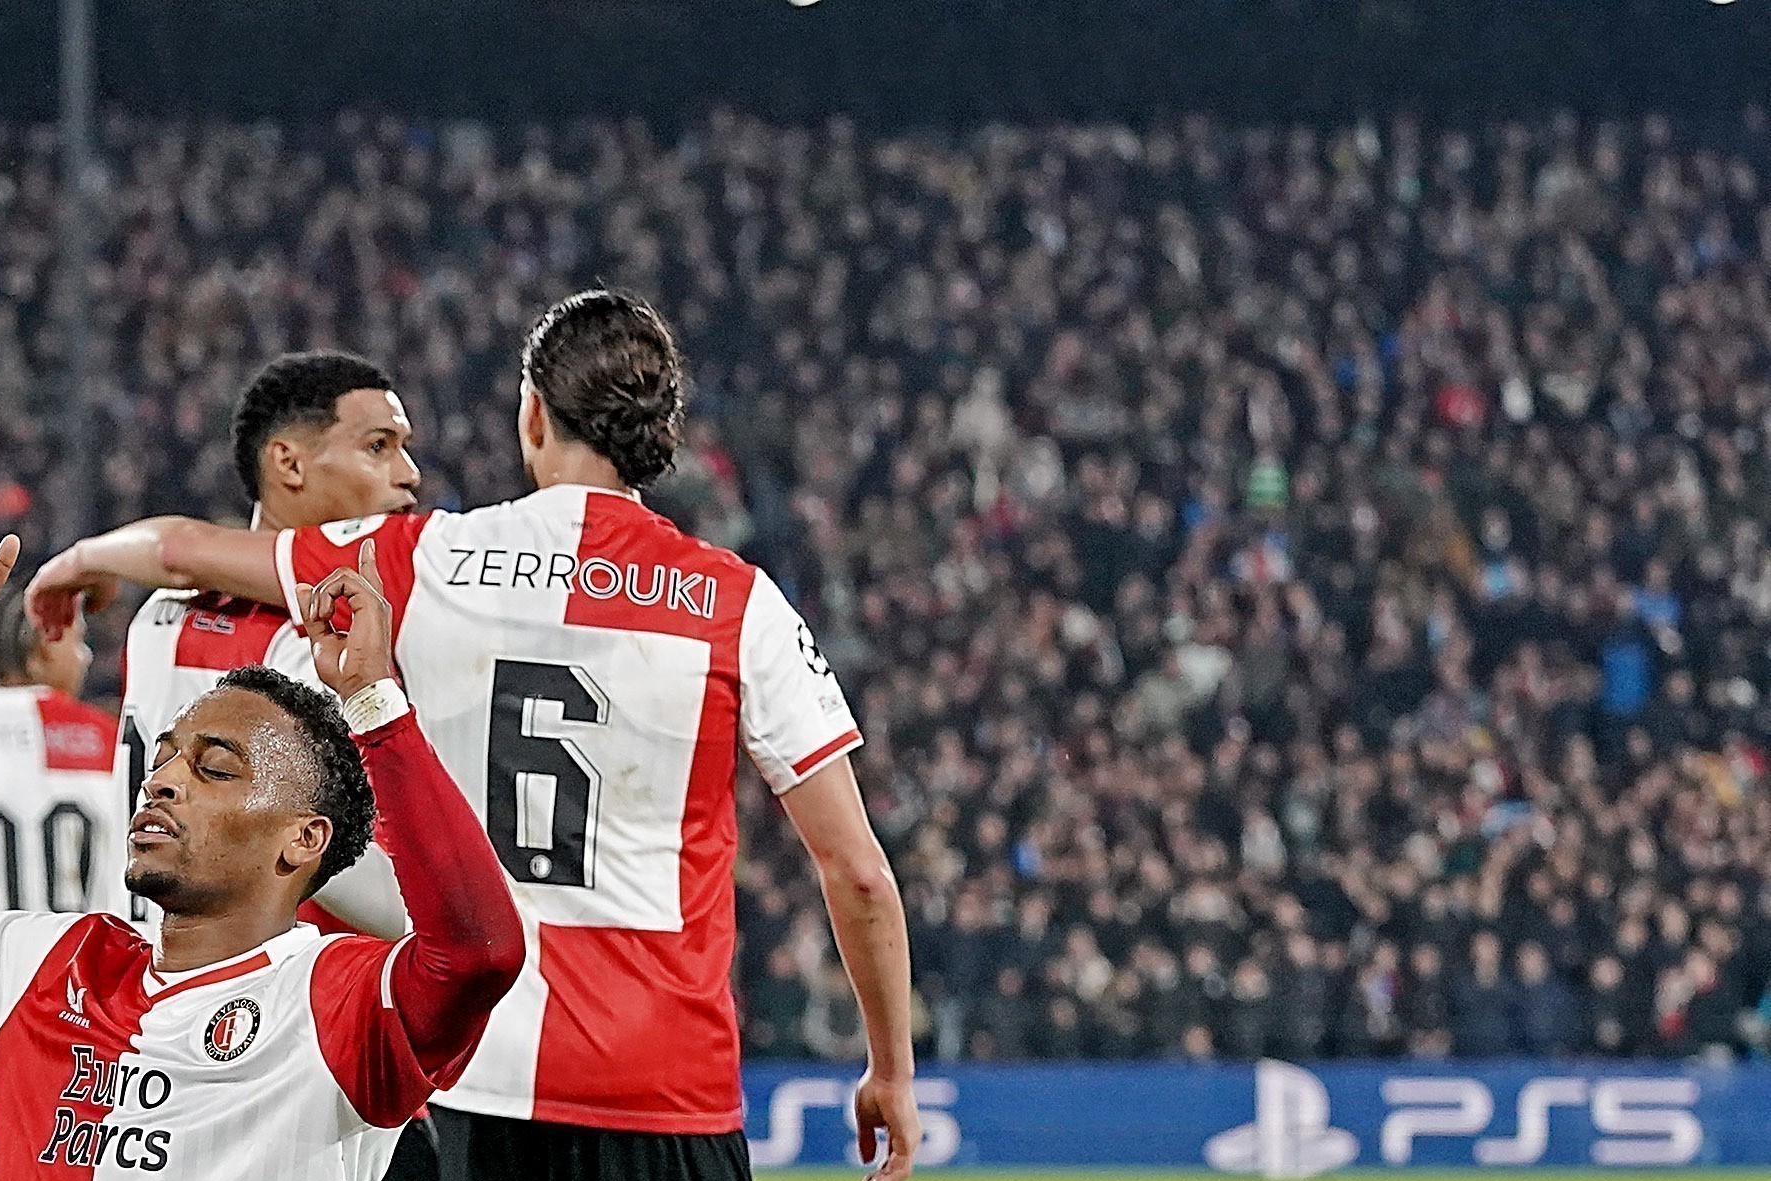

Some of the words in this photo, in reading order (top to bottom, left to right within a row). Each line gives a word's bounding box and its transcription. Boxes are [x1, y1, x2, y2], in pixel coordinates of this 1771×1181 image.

[447, 550, 717, 619] ZERROUKI
[486, 657, 610, 889] 6
[60, 1044, 172, 1110] Euro
[38, 1106, 172, 1172] Parcs
[742, 1077, 962, 1167] S5
[1379, 1077, 1705, 1166] PS5
